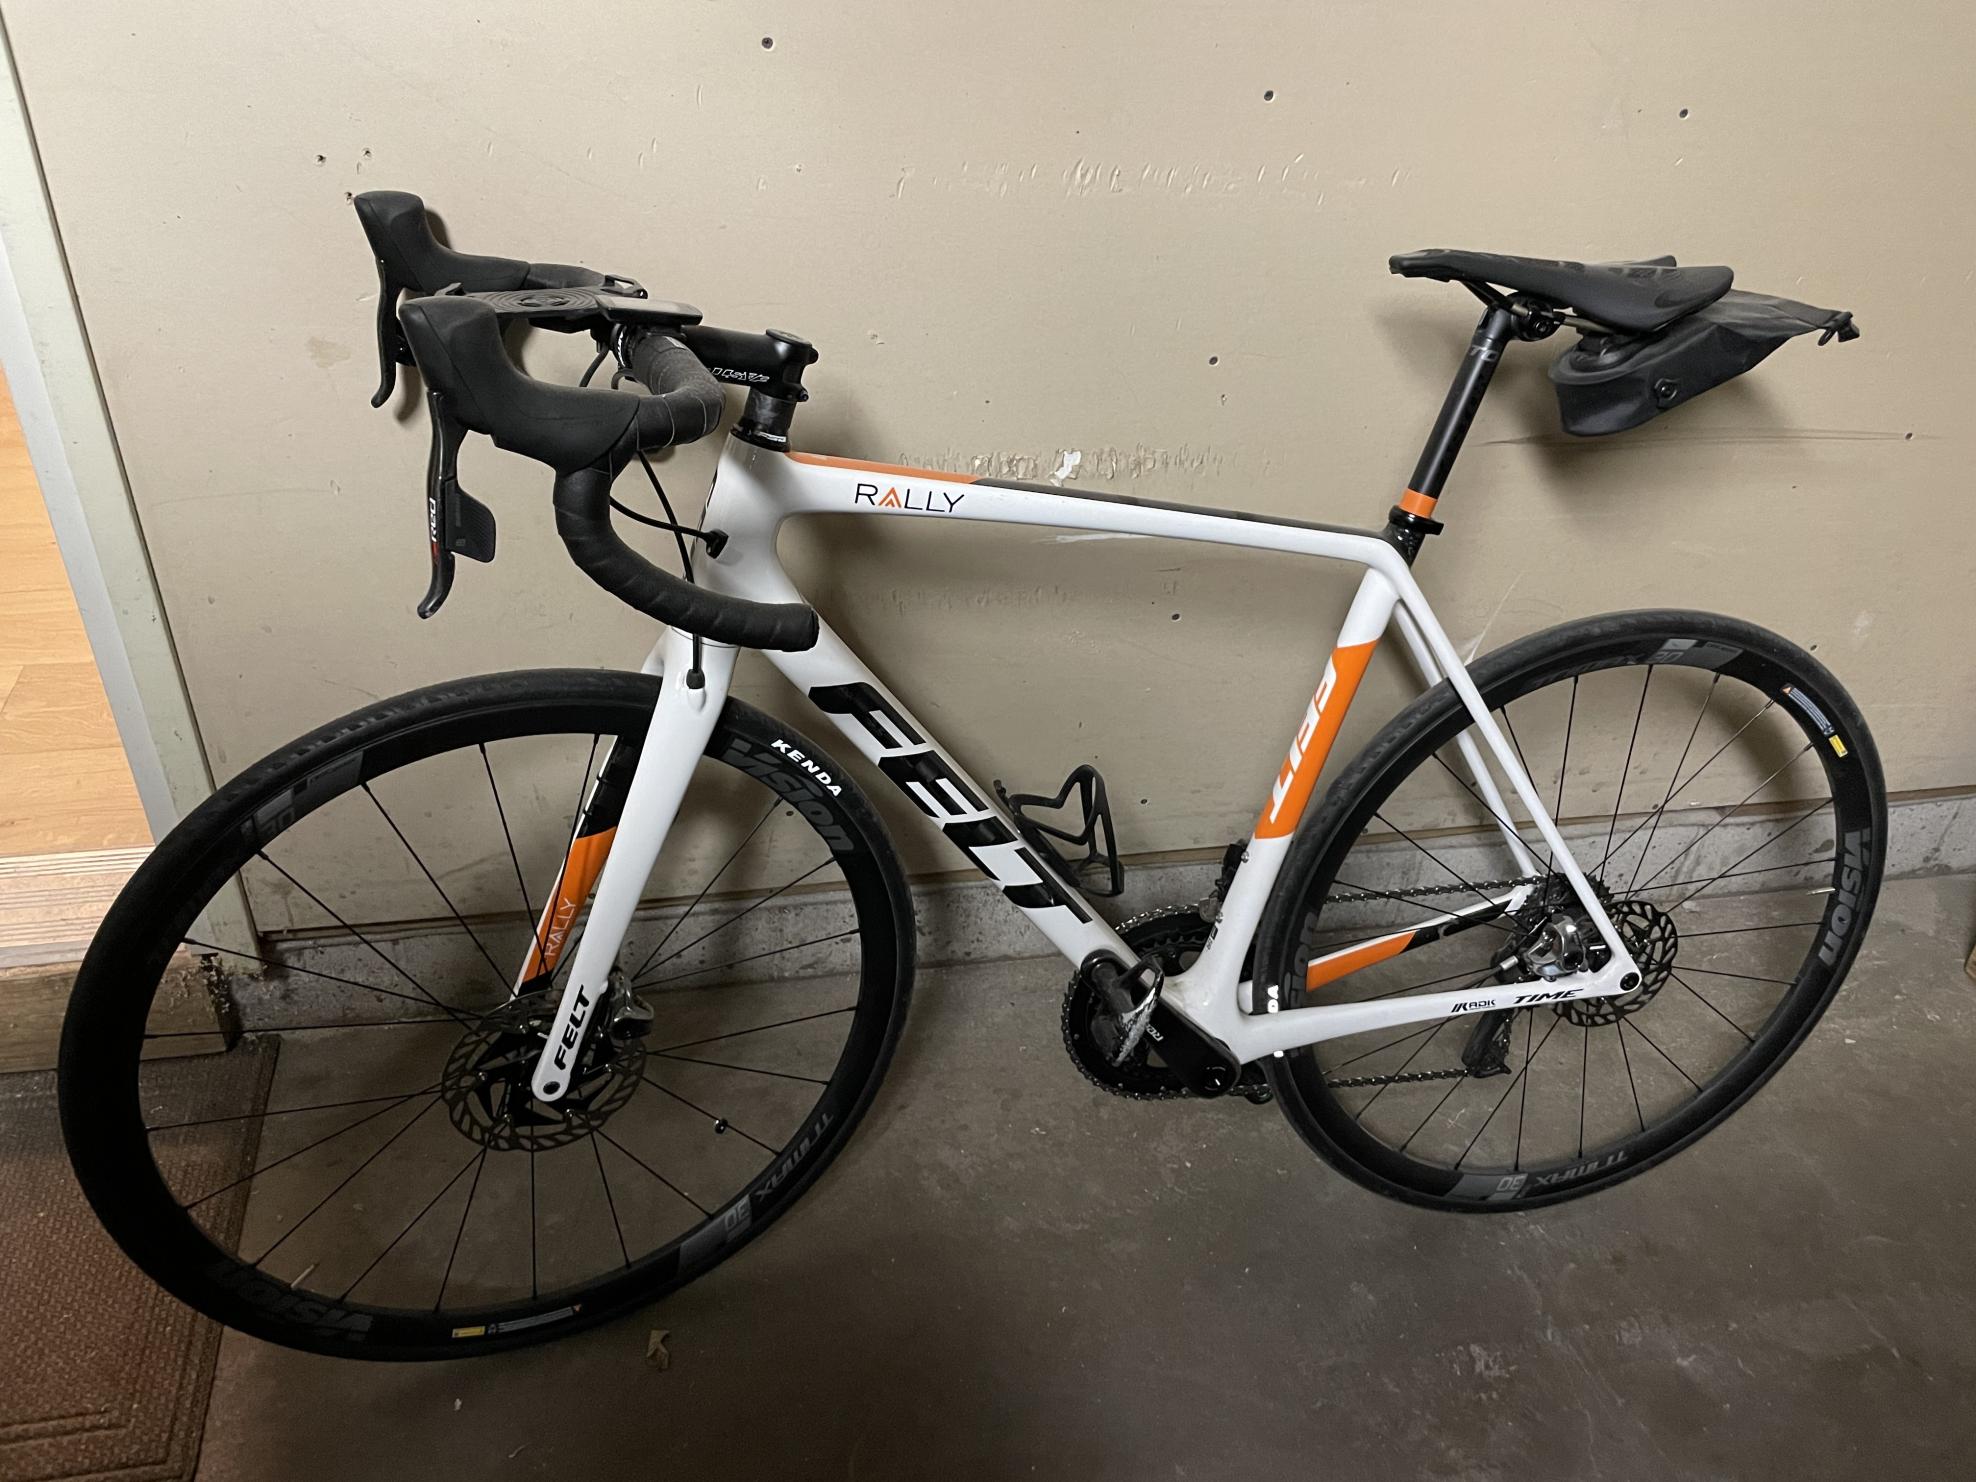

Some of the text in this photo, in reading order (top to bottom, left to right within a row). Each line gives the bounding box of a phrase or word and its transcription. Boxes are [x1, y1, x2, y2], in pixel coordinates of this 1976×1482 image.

[855, 483, 965, 513] RALLY
[771, 738, 844, 798] KENDA
[1269, 655, 1337, 824] FELT
[807, 682, 1092, 924] FELT
[544, 897, 577, 957] RALLY
[1513, 988, 1584, 1004] TIME
[554, 984, 591, 1071] FELT
[1496, 1174, 1528, 1192] 30
